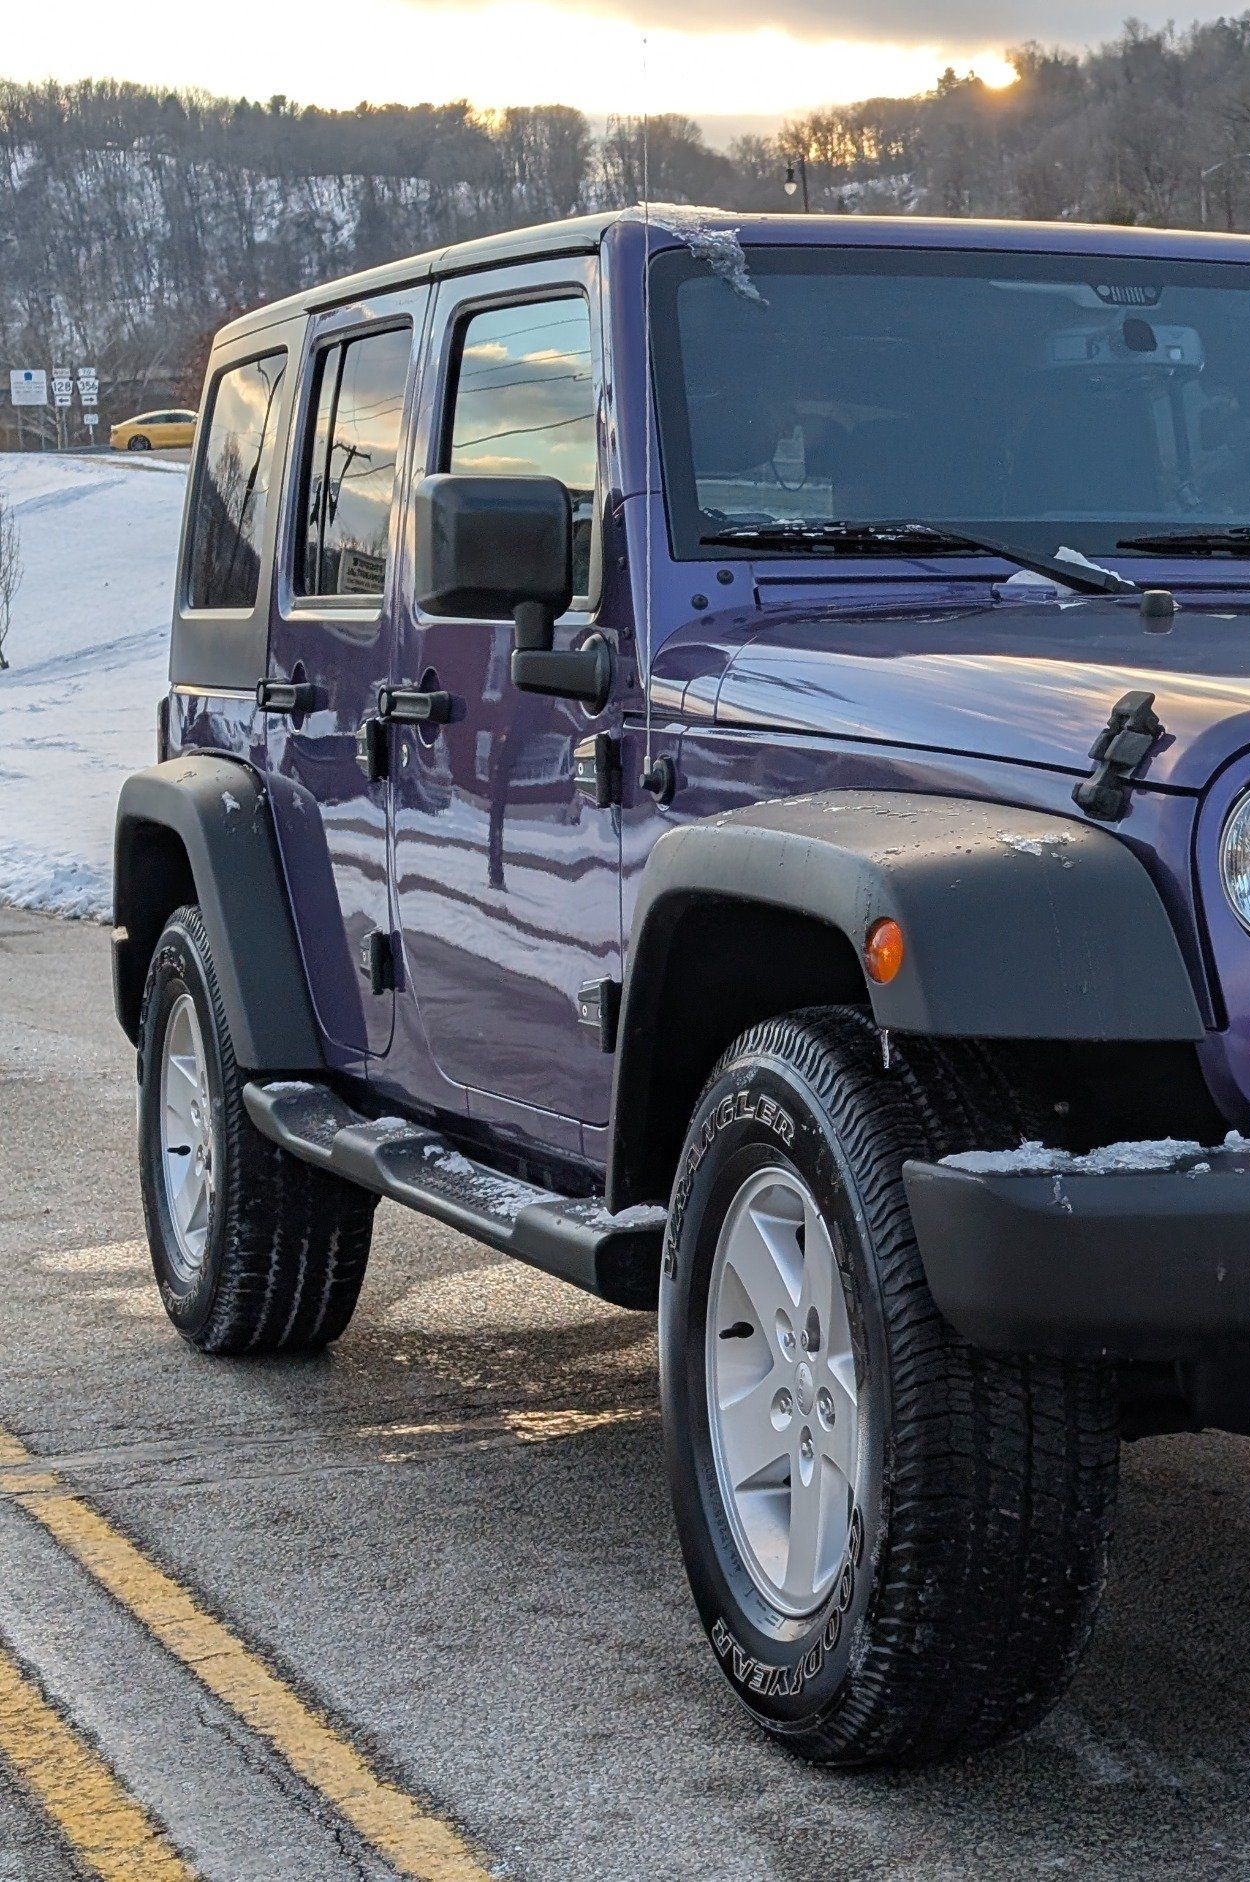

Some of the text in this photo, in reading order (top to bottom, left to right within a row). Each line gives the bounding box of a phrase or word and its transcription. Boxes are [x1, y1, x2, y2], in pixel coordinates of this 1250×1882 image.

[53, 381, 72, 392] 128
[79, 381, 98, 392] 356
[664, 1090, 796, 1280] WRANGLER
[711, 1504, 865, 1697] GOODYEAR
